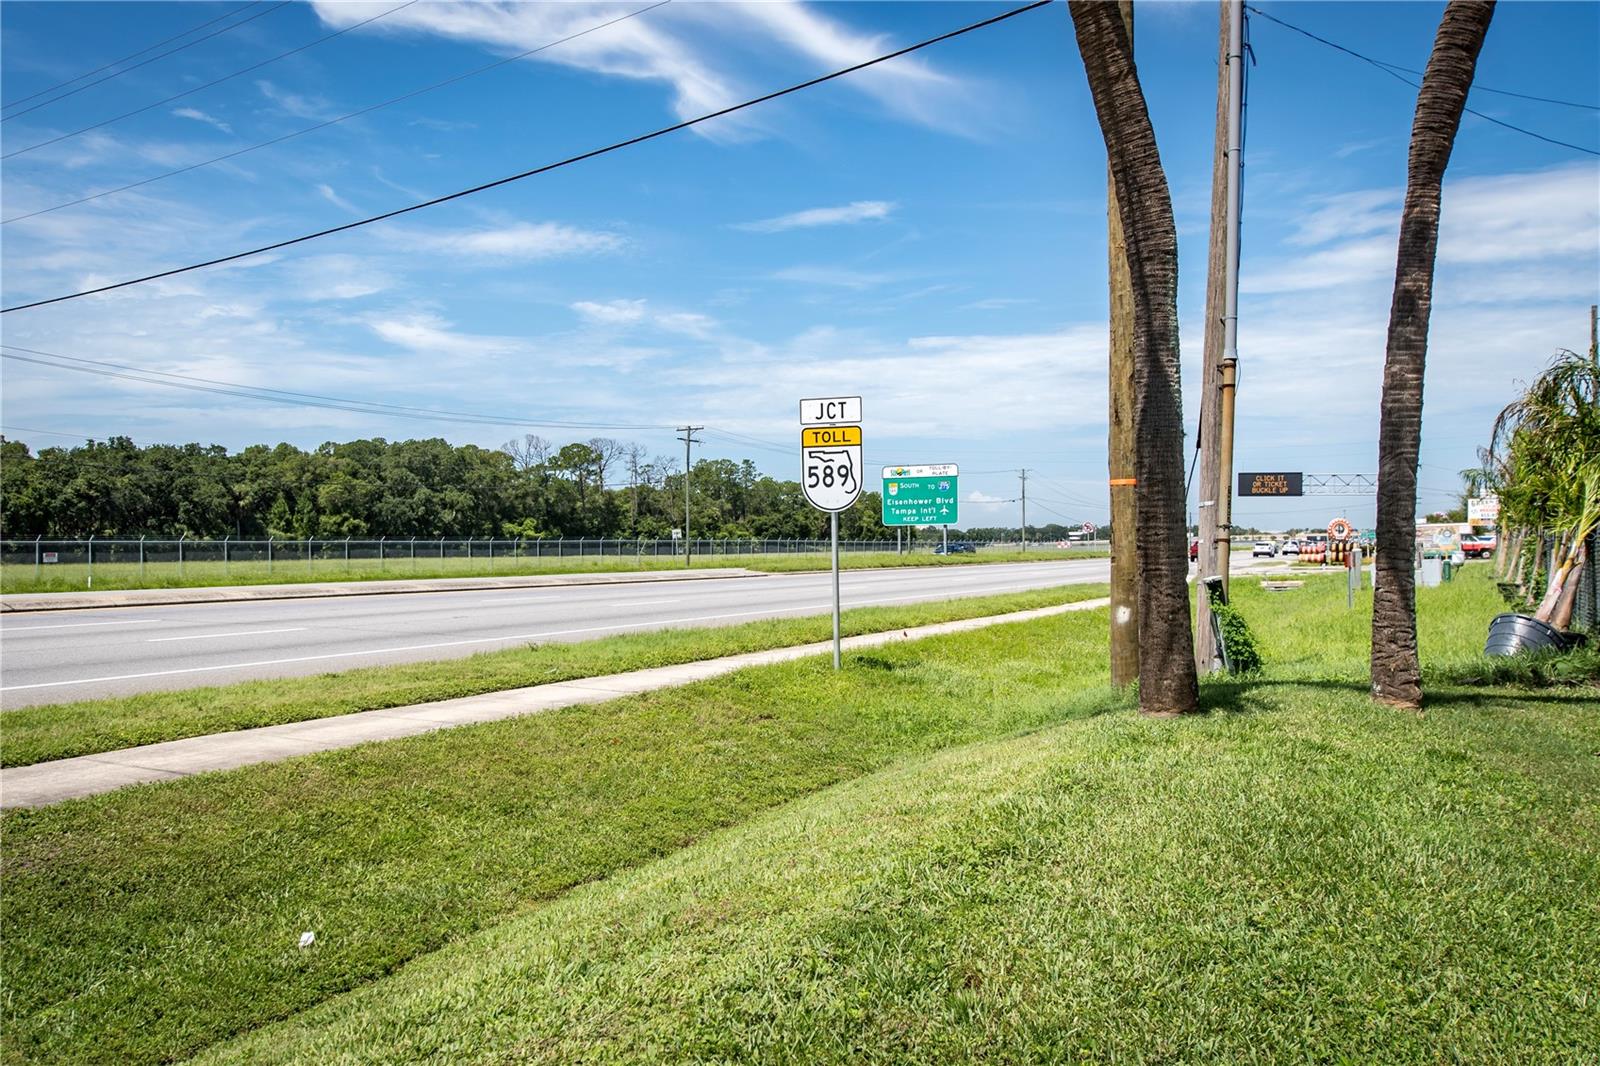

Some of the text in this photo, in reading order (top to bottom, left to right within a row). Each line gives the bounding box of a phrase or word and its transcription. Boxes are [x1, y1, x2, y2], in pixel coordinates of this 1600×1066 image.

[816, 402, 846, 420] JCT
[813, 431, 851, 443] TOLL
[808, 465, 849, 488] 589
